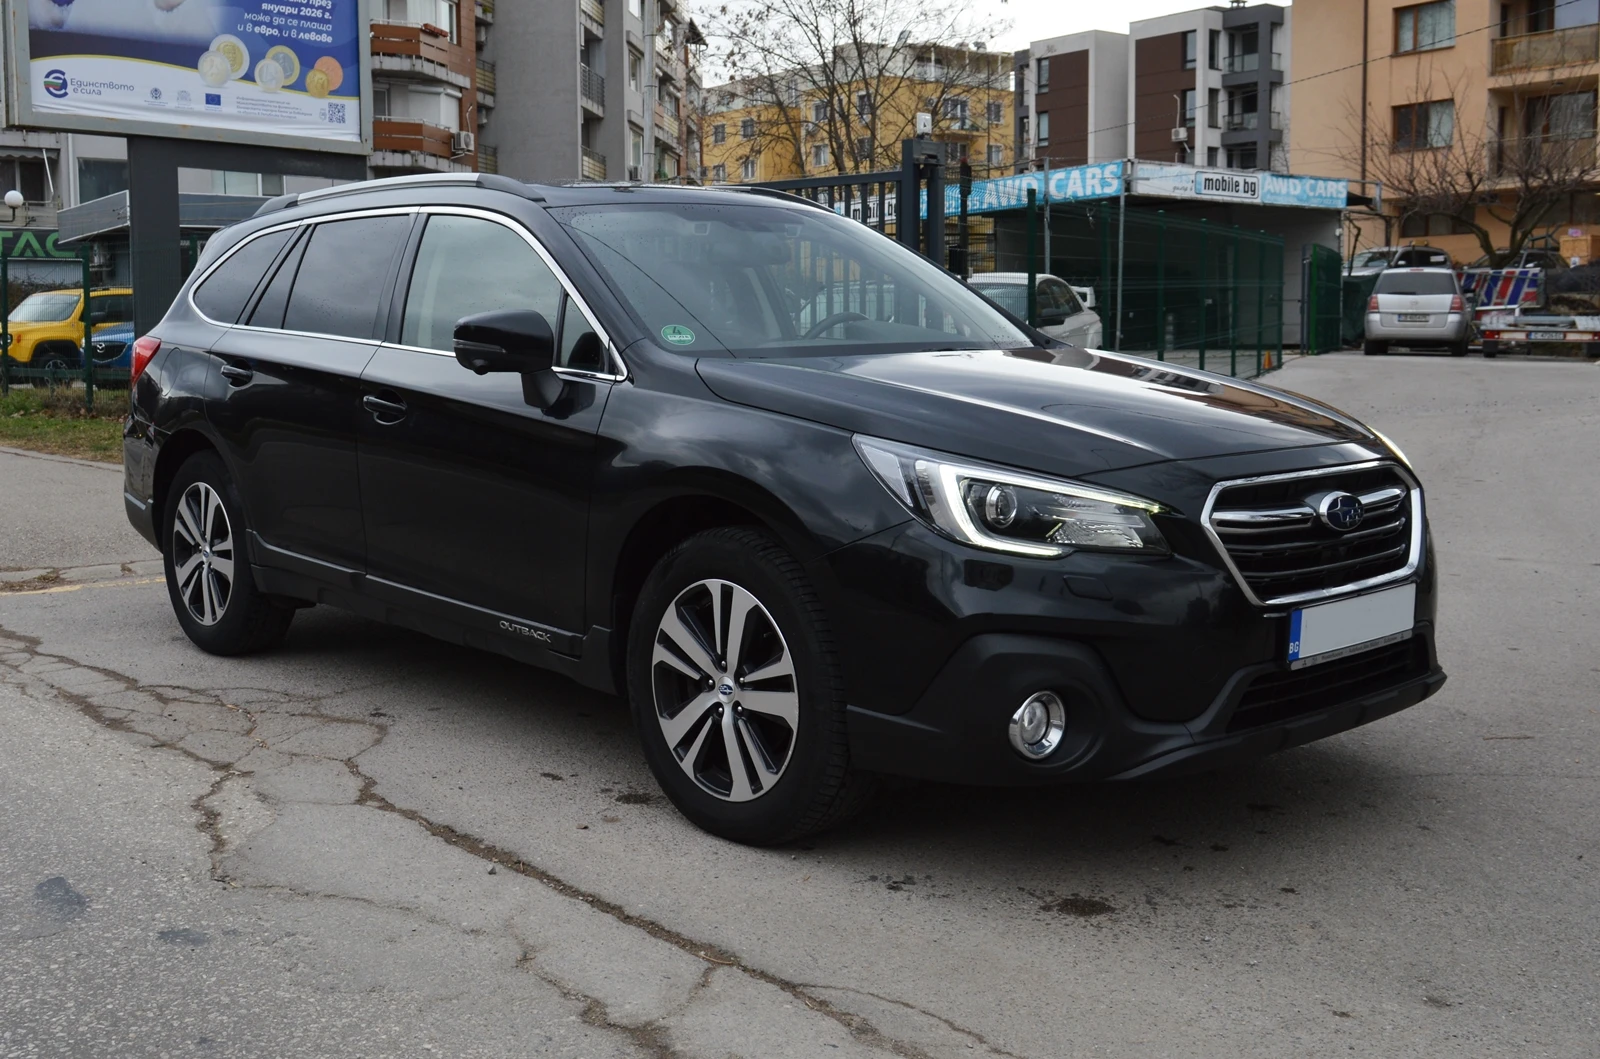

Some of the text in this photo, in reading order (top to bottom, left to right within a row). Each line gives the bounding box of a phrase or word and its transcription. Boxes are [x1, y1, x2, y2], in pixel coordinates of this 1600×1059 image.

[262, 3, 298, 15] януари
[300, 7, 323, 18] 2026
[244, 12, 332, 31] може да се плаща
[246, 23, 252, 32] в
[254, 25, 280, 37] евро,
[290, 29, 297, 38] в
[298, 32, 332, 43] левове
[70, 78, 135, 91] Единството
[80, 88, 102, 96] сила
[984, 176, 1038, 208] AWD
[1049, 164, 1118, 199] CARS
[1263, 175, 1347, 198] AWD CARS
[499, 620, 551, 643] OUTBACK
[1289, 641, 1299, 654] BG
